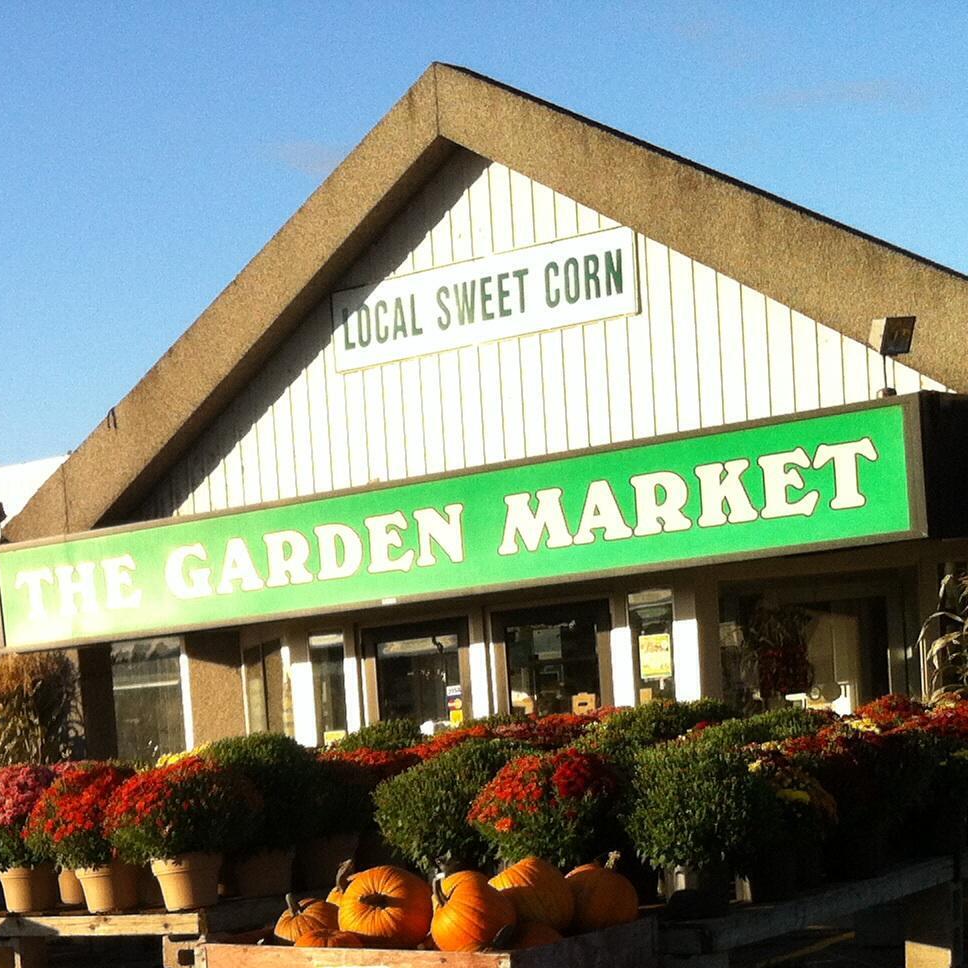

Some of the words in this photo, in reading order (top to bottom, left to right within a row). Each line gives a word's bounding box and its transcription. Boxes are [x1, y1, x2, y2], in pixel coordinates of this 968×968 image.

[342, 294, 423, 350] LOCAL
[436, 268, 529, 331] SWEET
[544, 248, 624, 309] CORN
[15, 554, 142, 626] THE
[164, 503, 464, 600] GARDEN
[497, 436, 879, 556] MARKET
